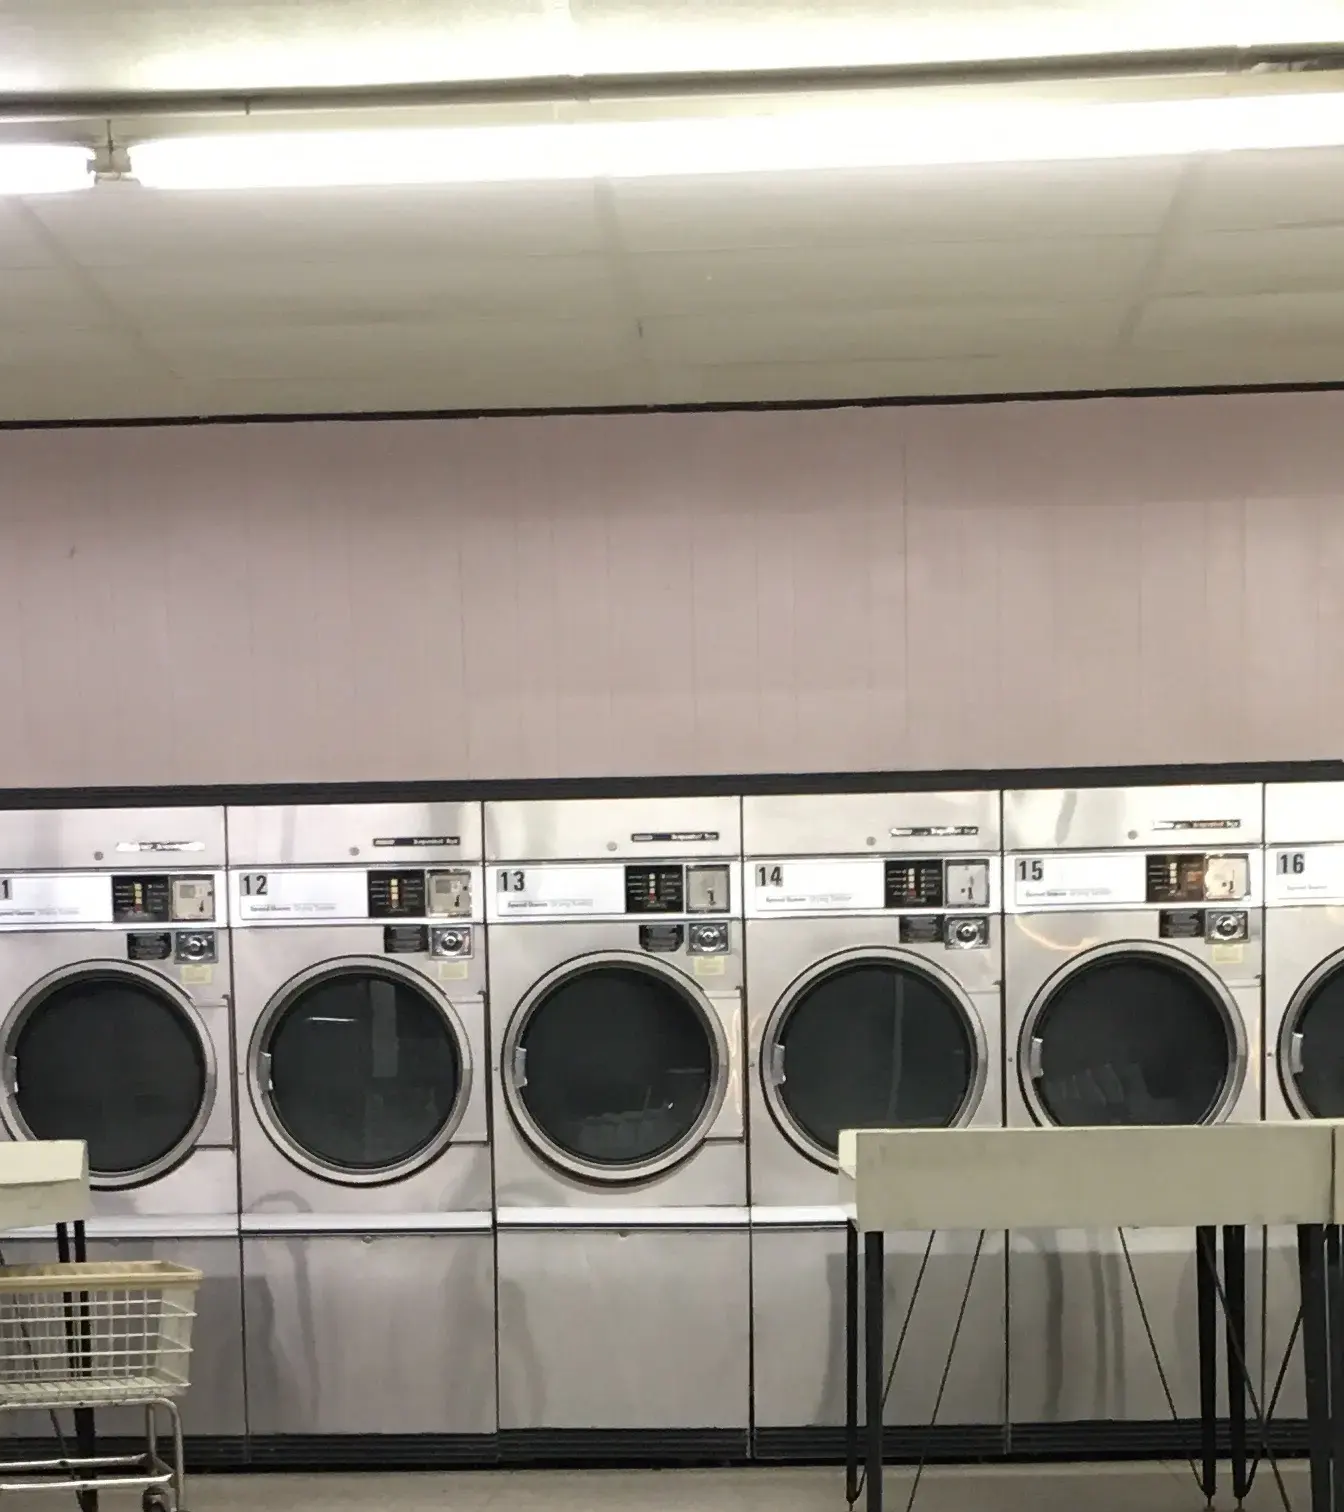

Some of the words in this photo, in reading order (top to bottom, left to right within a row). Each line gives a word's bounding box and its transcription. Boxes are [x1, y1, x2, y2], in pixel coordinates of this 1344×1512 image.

[1018, 860, 1043, 881] 15
[1280, 853, 1305, 874] 16
[242, 875, 268, 896] 12
[500, 871, 525, 892] 13
[758, 866, 783, 887] 14
